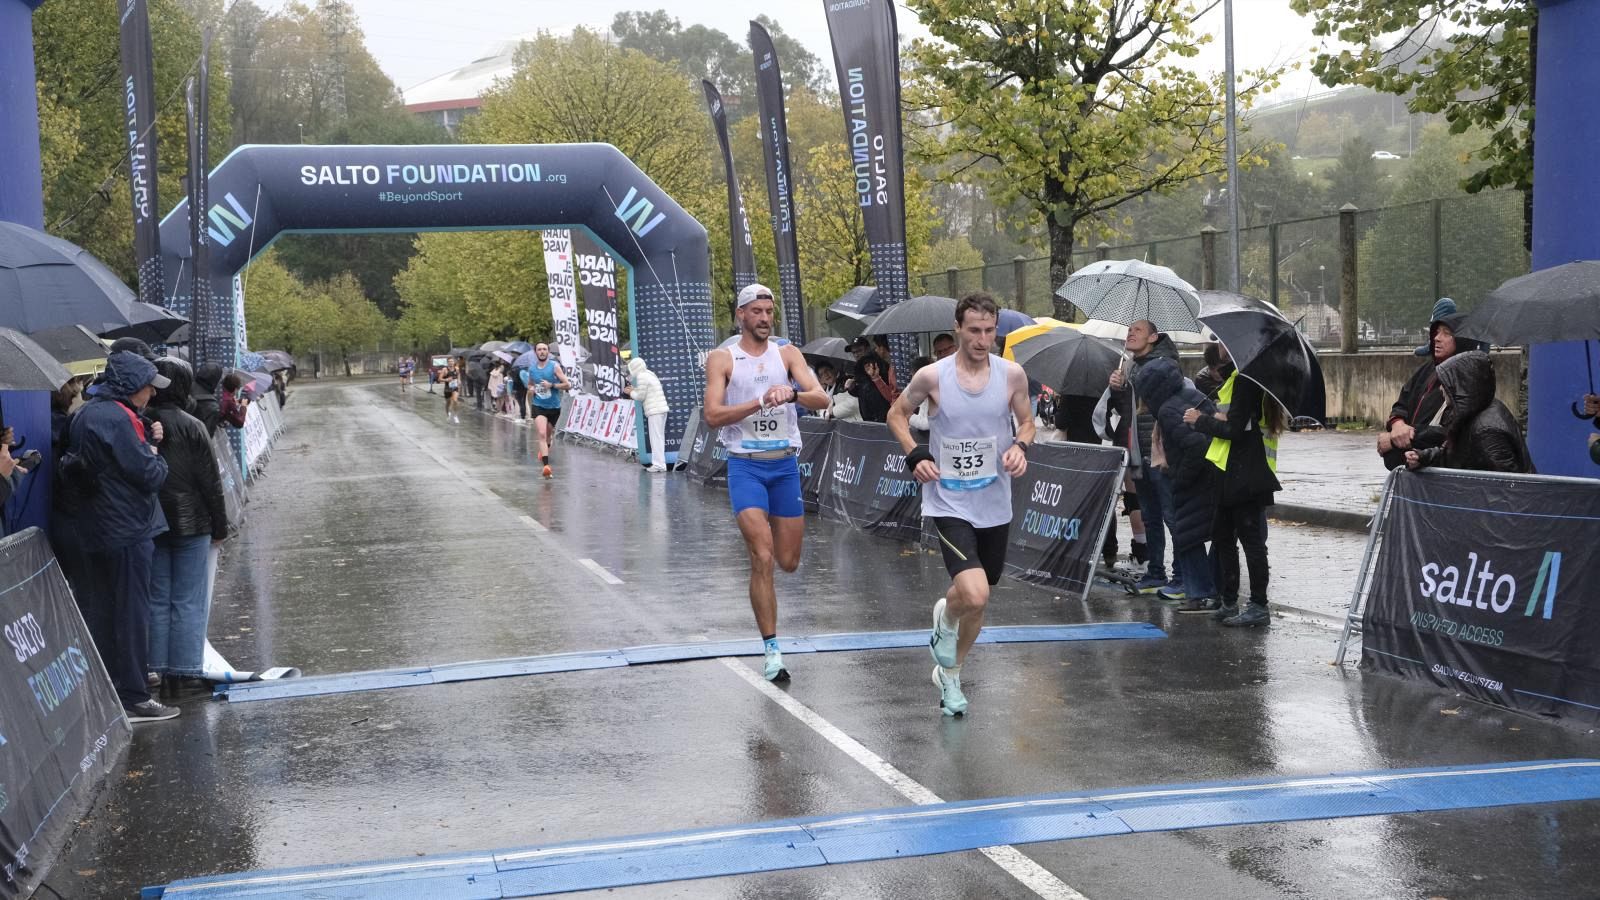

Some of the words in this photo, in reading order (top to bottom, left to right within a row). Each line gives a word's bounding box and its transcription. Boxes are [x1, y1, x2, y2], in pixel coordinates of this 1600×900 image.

[300, 165, 380, 185] SALTO
[386, 163, 541, 185] FOUNDATION
[545, 173, 567, 185] .org
[378, 191, 463, 204] #BeyondSport
[753, 420, 778, 432] 150
[952, 454, 984, 469] 333
[1031, 480, 1062, 507] SALTO
[1419, 552, 1516, 614] salto
[4, 612, 46, 663] SALTO
[1458, 623, 1504, 646] ACCESS
